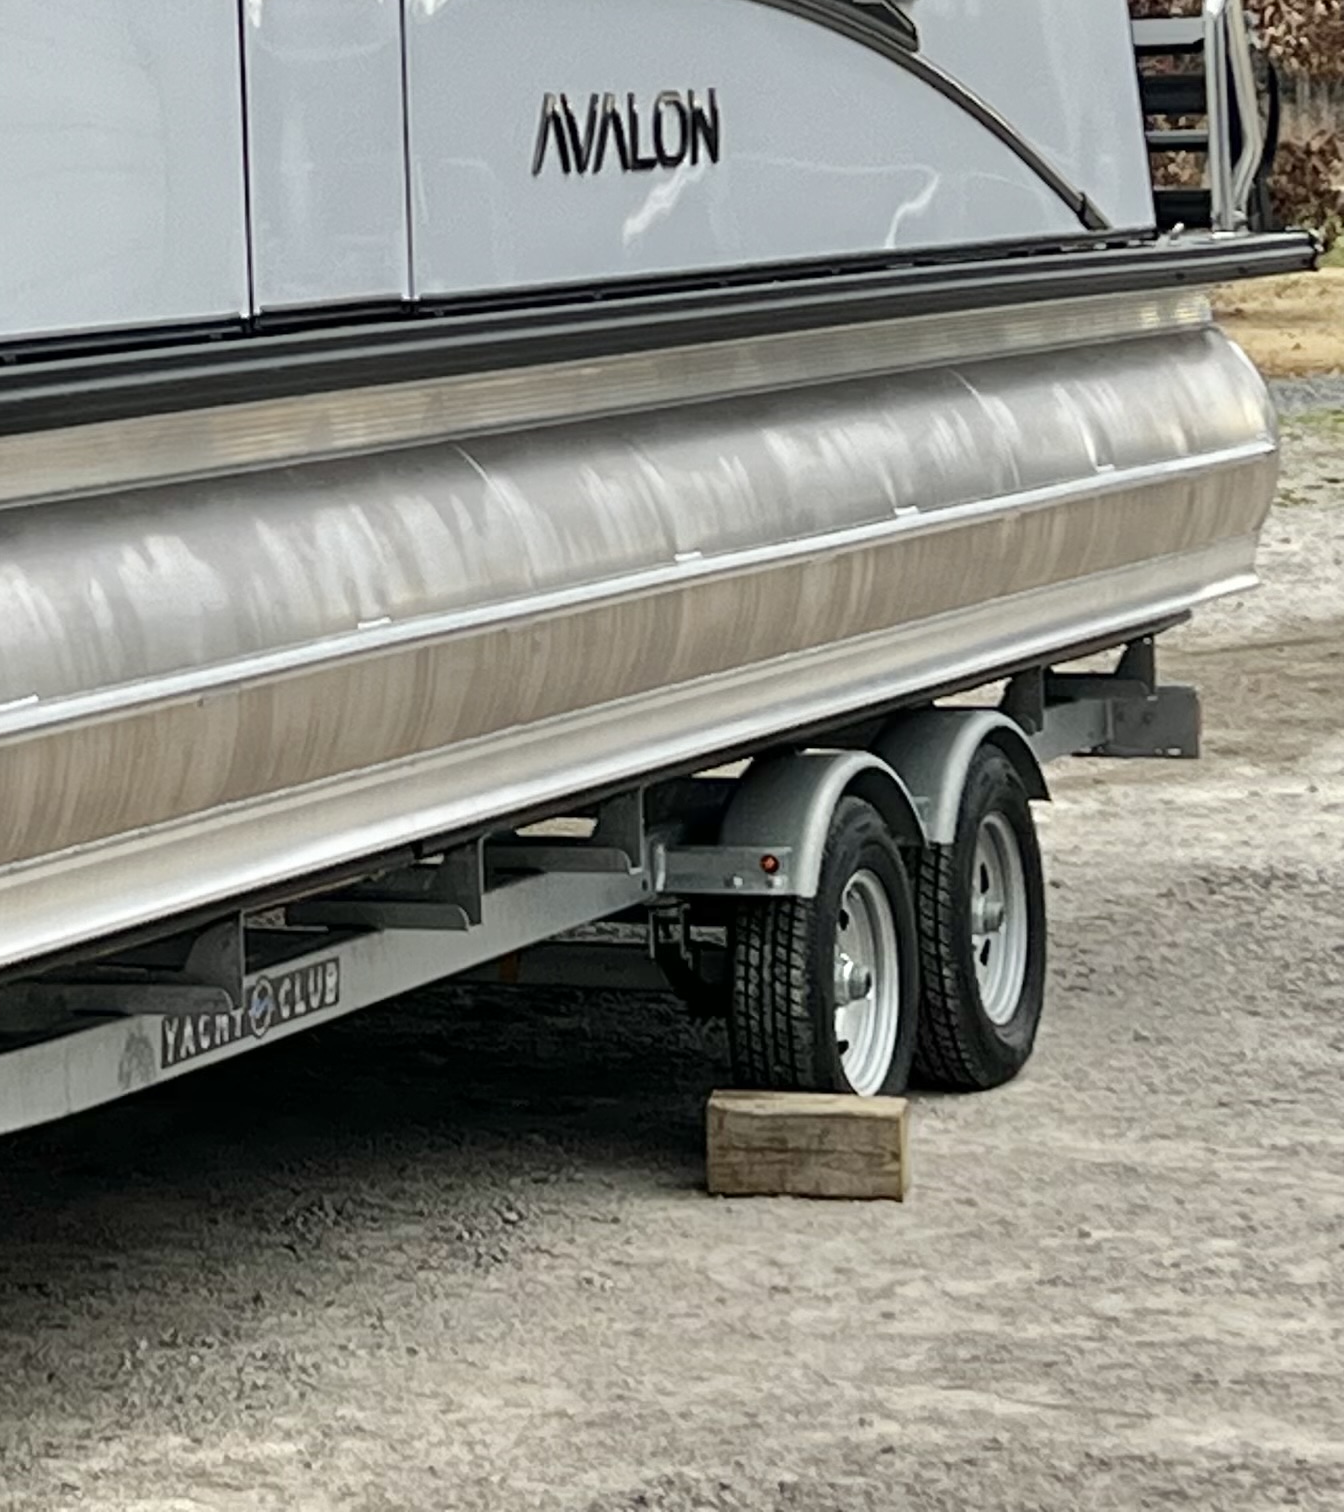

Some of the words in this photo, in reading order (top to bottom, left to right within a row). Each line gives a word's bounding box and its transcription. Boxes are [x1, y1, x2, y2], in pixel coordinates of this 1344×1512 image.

[532, 87, 720, 176] AVALON
[163, 1008, 244, 1065] YACHT
[278, 960, 338, 1019] CLUB
